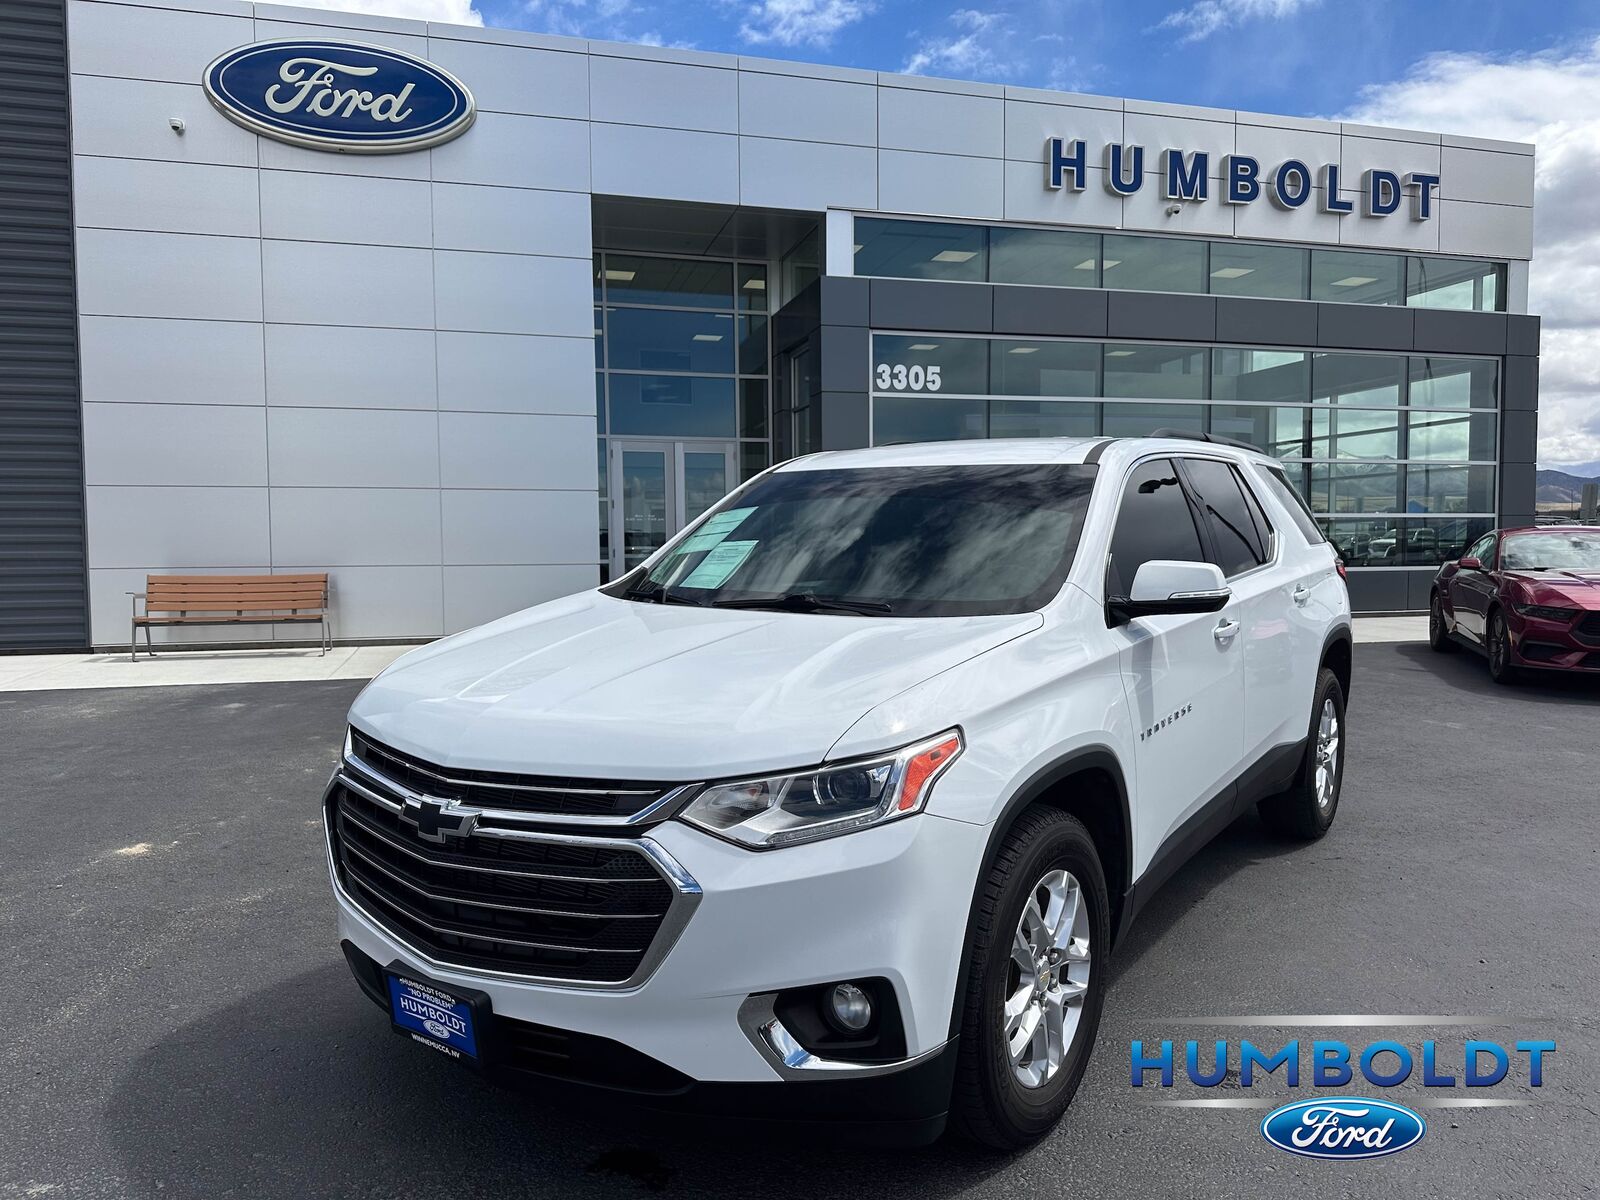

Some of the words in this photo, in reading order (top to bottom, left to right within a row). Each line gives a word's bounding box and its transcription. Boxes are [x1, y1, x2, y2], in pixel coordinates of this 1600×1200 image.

[264, 57, 416, 123] Ford
[1045, 136, 1440, 221] HUMBOLDT
[876, 363, 942, 391] 3305
[1140, 703, 1192, 742] TRAVERSE
[402, 978, 435, 995] HUMBOLDT
[435, 990, 452, 1002] FORD
[400, 997, 467, 1033] HUMBOLDT
[429, 1022, 445, 1036] Ford
